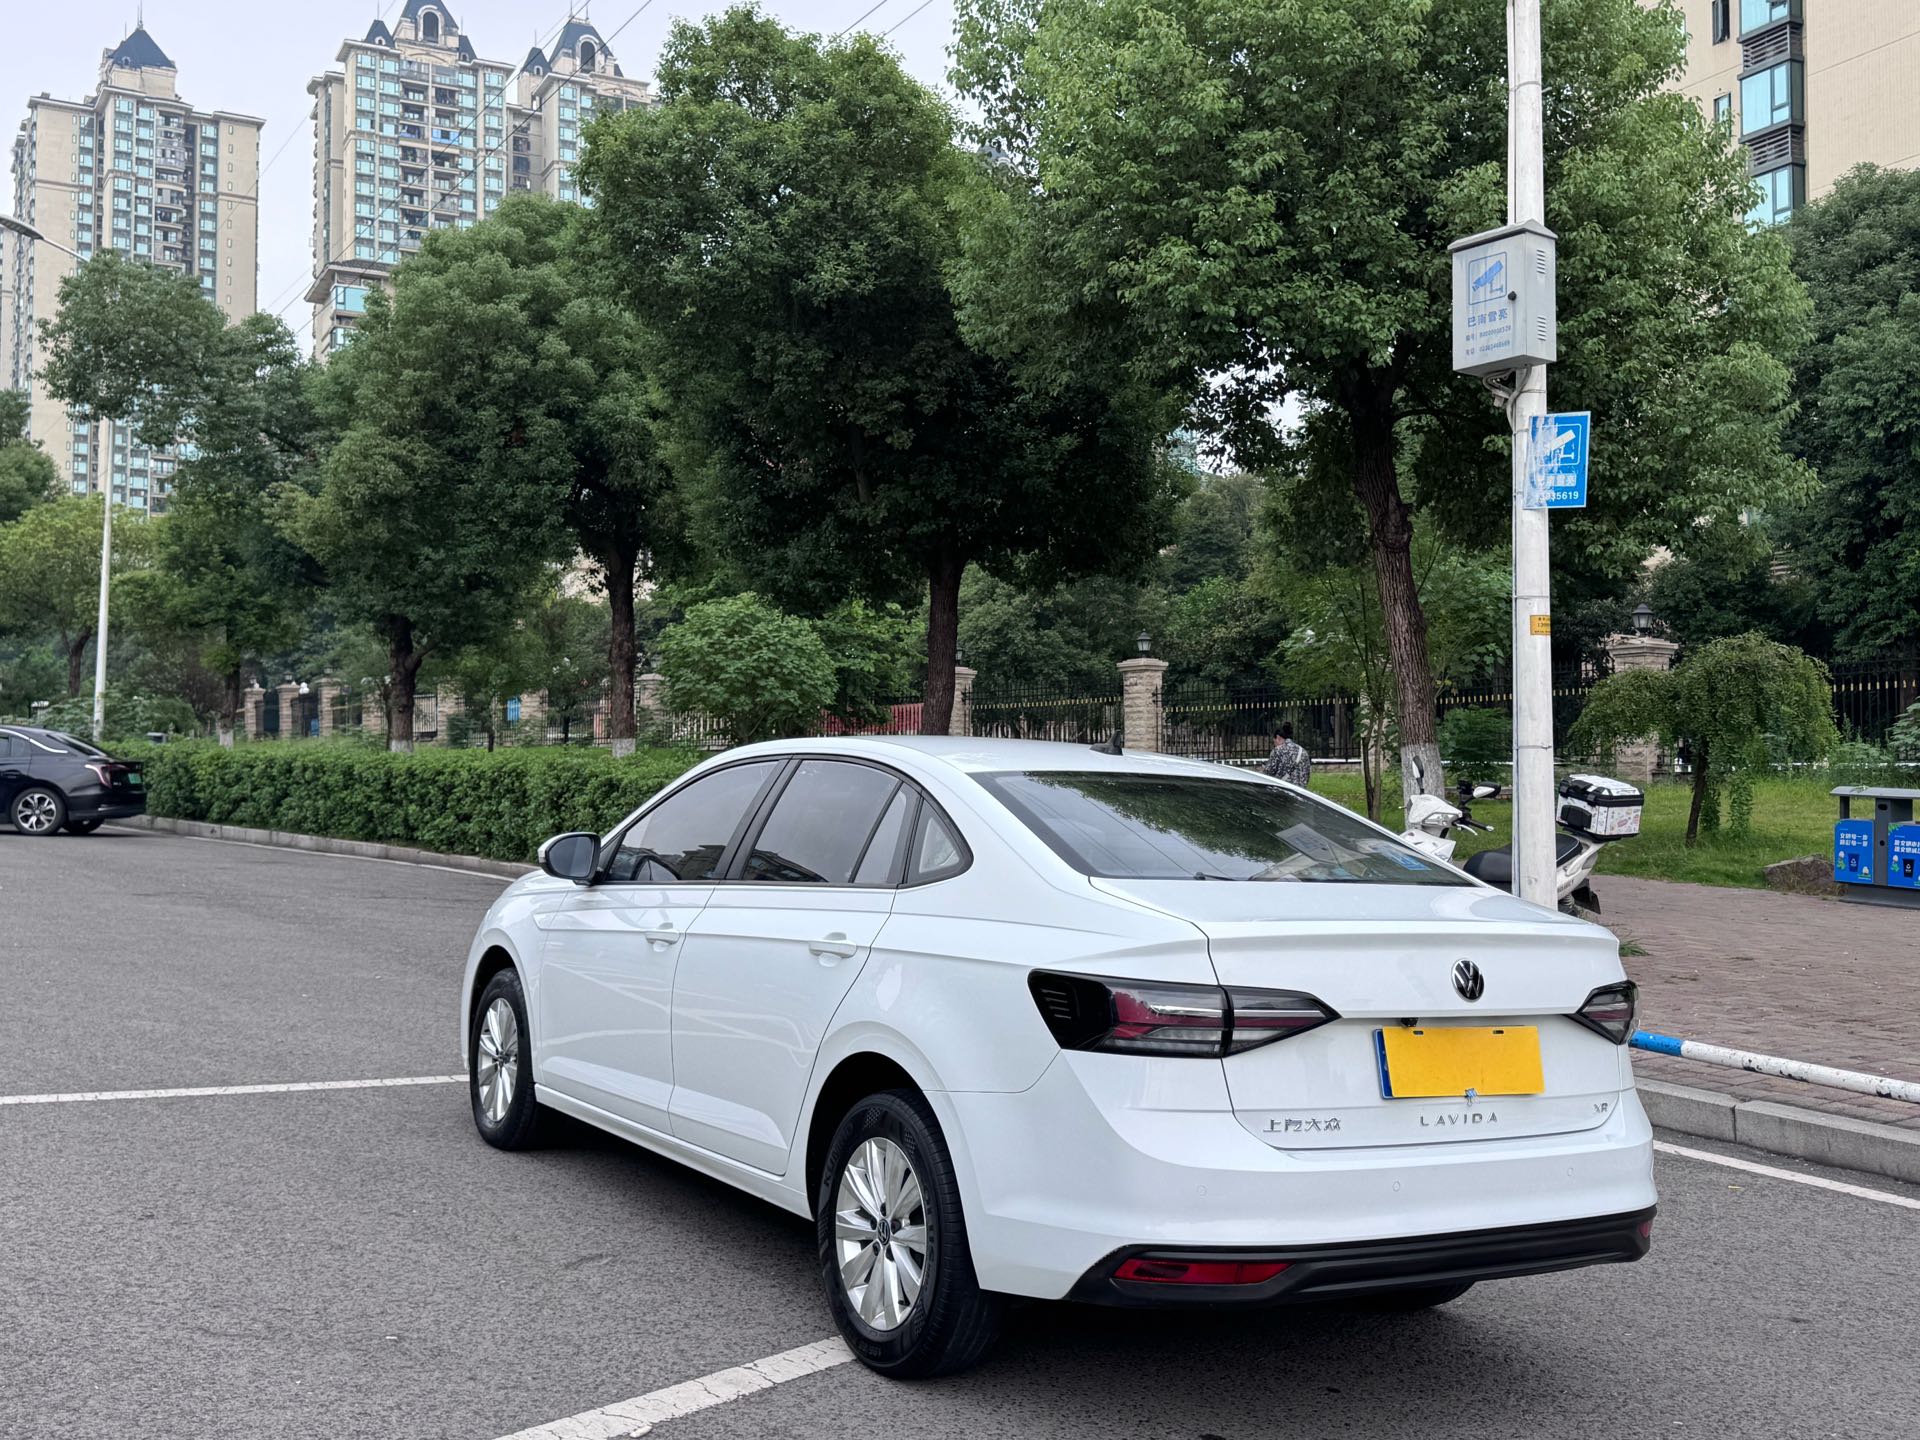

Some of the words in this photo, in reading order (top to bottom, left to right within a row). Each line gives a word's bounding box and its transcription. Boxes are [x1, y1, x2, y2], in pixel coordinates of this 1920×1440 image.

[1262, 1118, 1341, 1133] 上汽大众
[1420, 1112, 1498, 1127] LAVIDA
